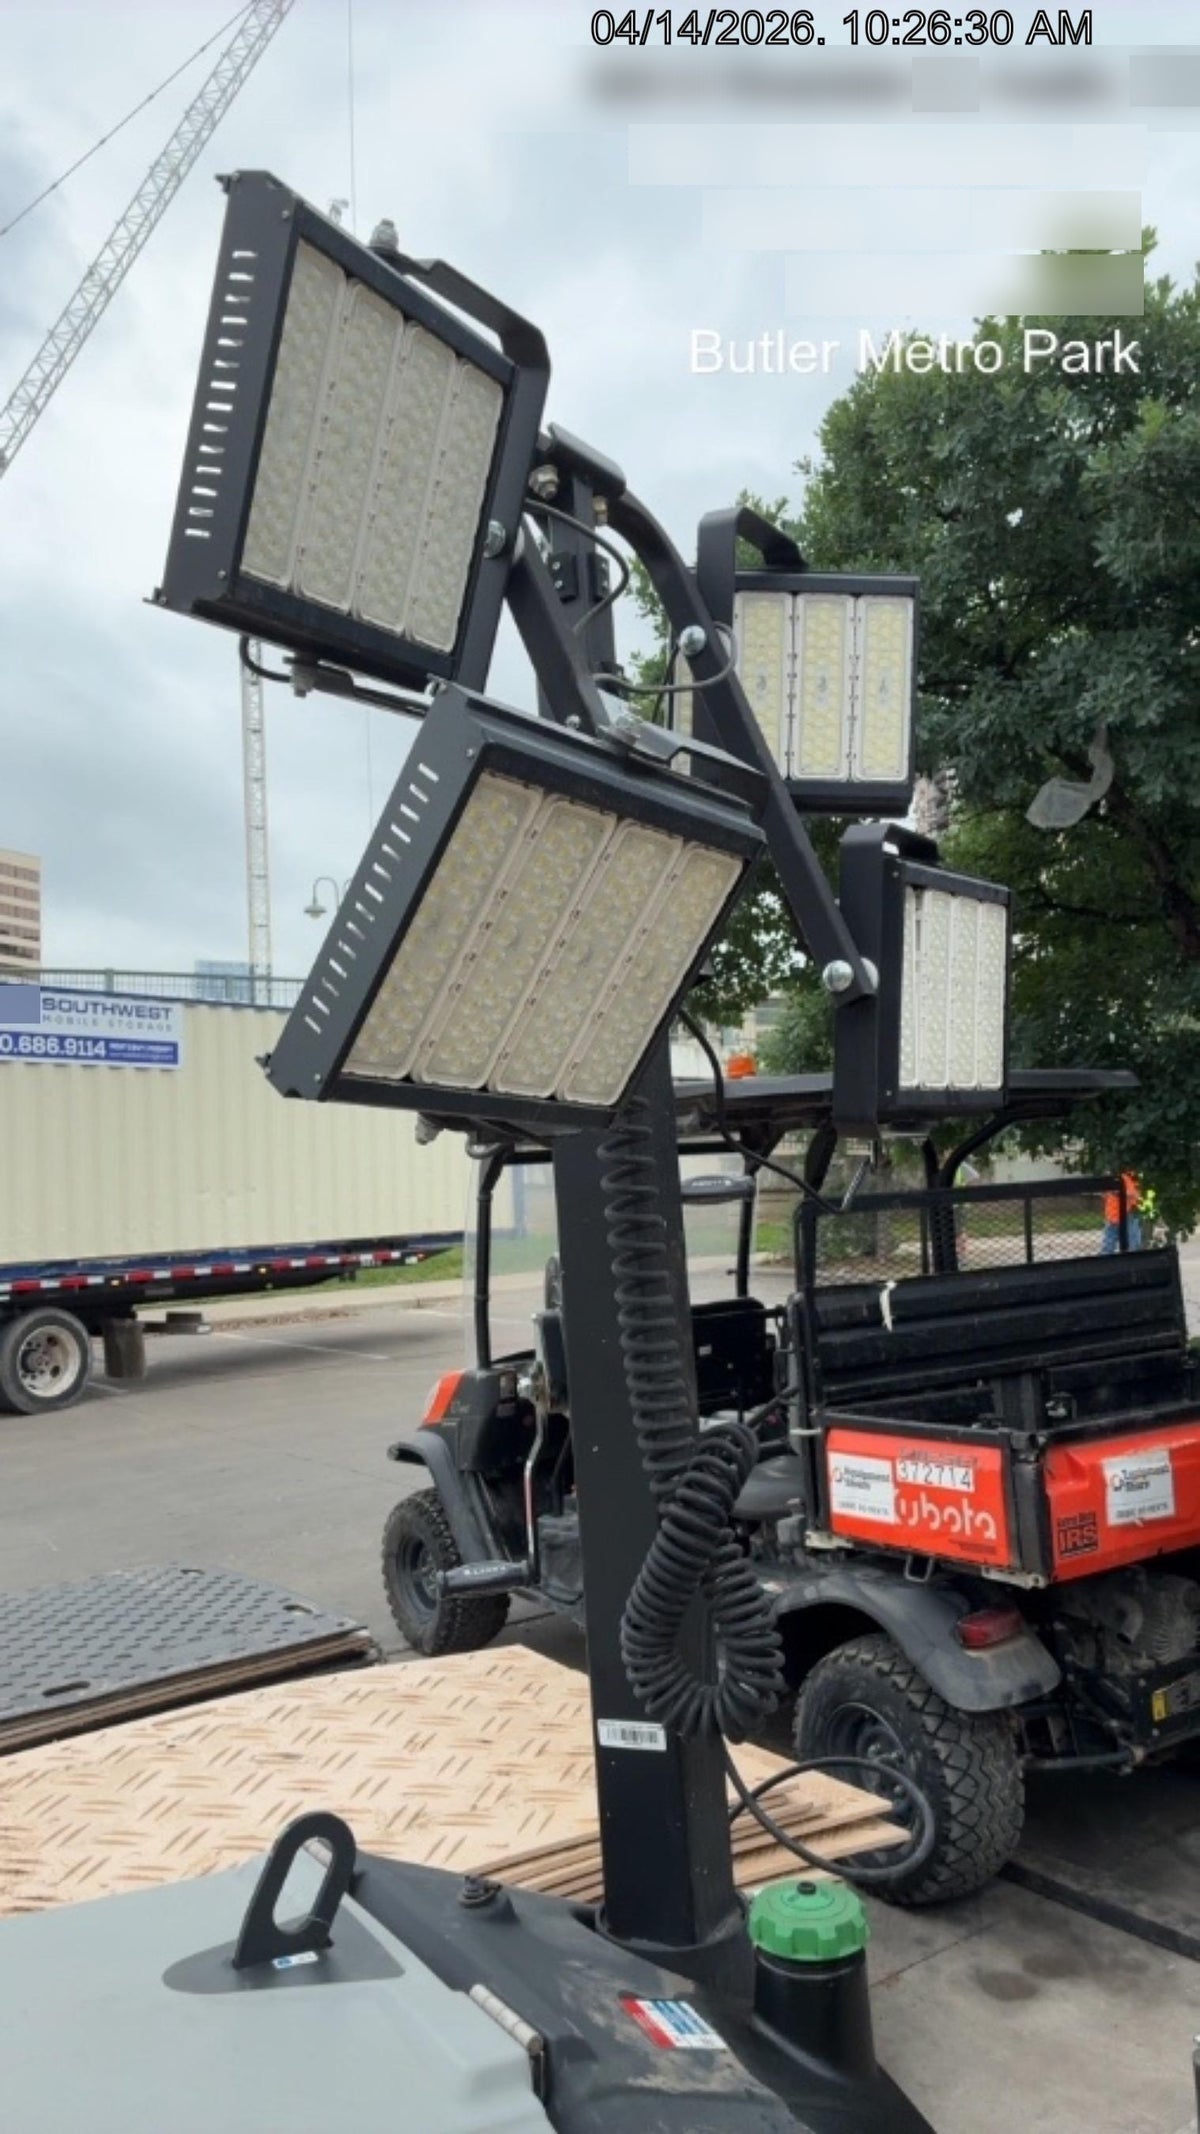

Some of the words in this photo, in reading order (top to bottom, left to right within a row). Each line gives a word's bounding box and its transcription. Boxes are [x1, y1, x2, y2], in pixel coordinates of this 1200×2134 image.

[42, 997, 173, 1021] SOUTHWEST
[42, 1014, 99, 1028] MOBILE
[108, 1018, 173, 1032] STORAGE
[894, 1487, 997, 1540] ubota
